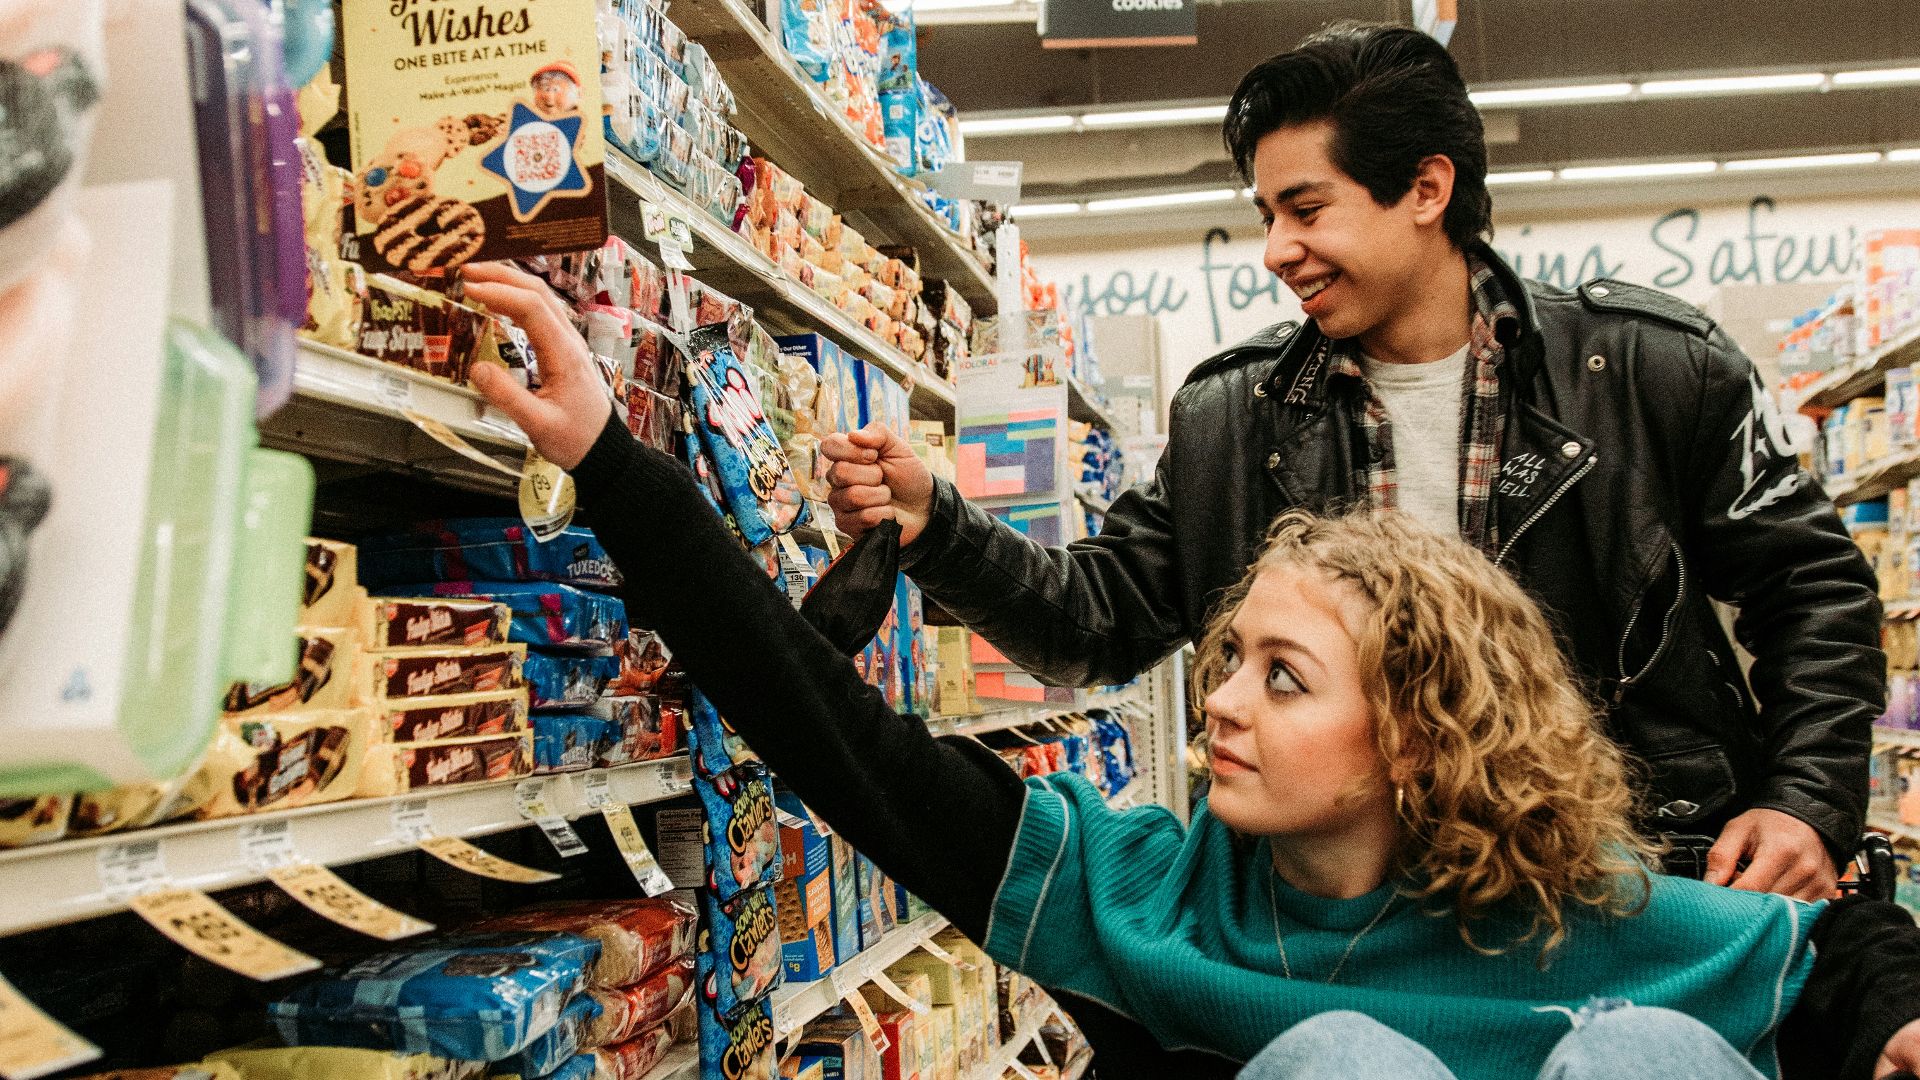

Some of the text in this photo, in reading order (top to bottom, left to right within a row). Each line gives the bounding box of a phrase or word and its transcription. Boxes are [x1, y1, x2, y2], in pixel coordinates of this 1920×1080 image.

[402, 5, 533, 47] Wishes
[394, 40, 547, 71] ONE BITE AT A TIME
[445, 72, 499, 84] Experience
[1065, 270, 1189, 318] you
[1501, 460, 1539, 484] WAS
[1511, 452, 1546, 470] ALL
[566, 559, 616, 581] TUXEDOS
[728, 795, 773, 855] Crawlers
[730, 906, 775, 971] Crawlers
[723, 1017, 773, 1080] Crawlers
